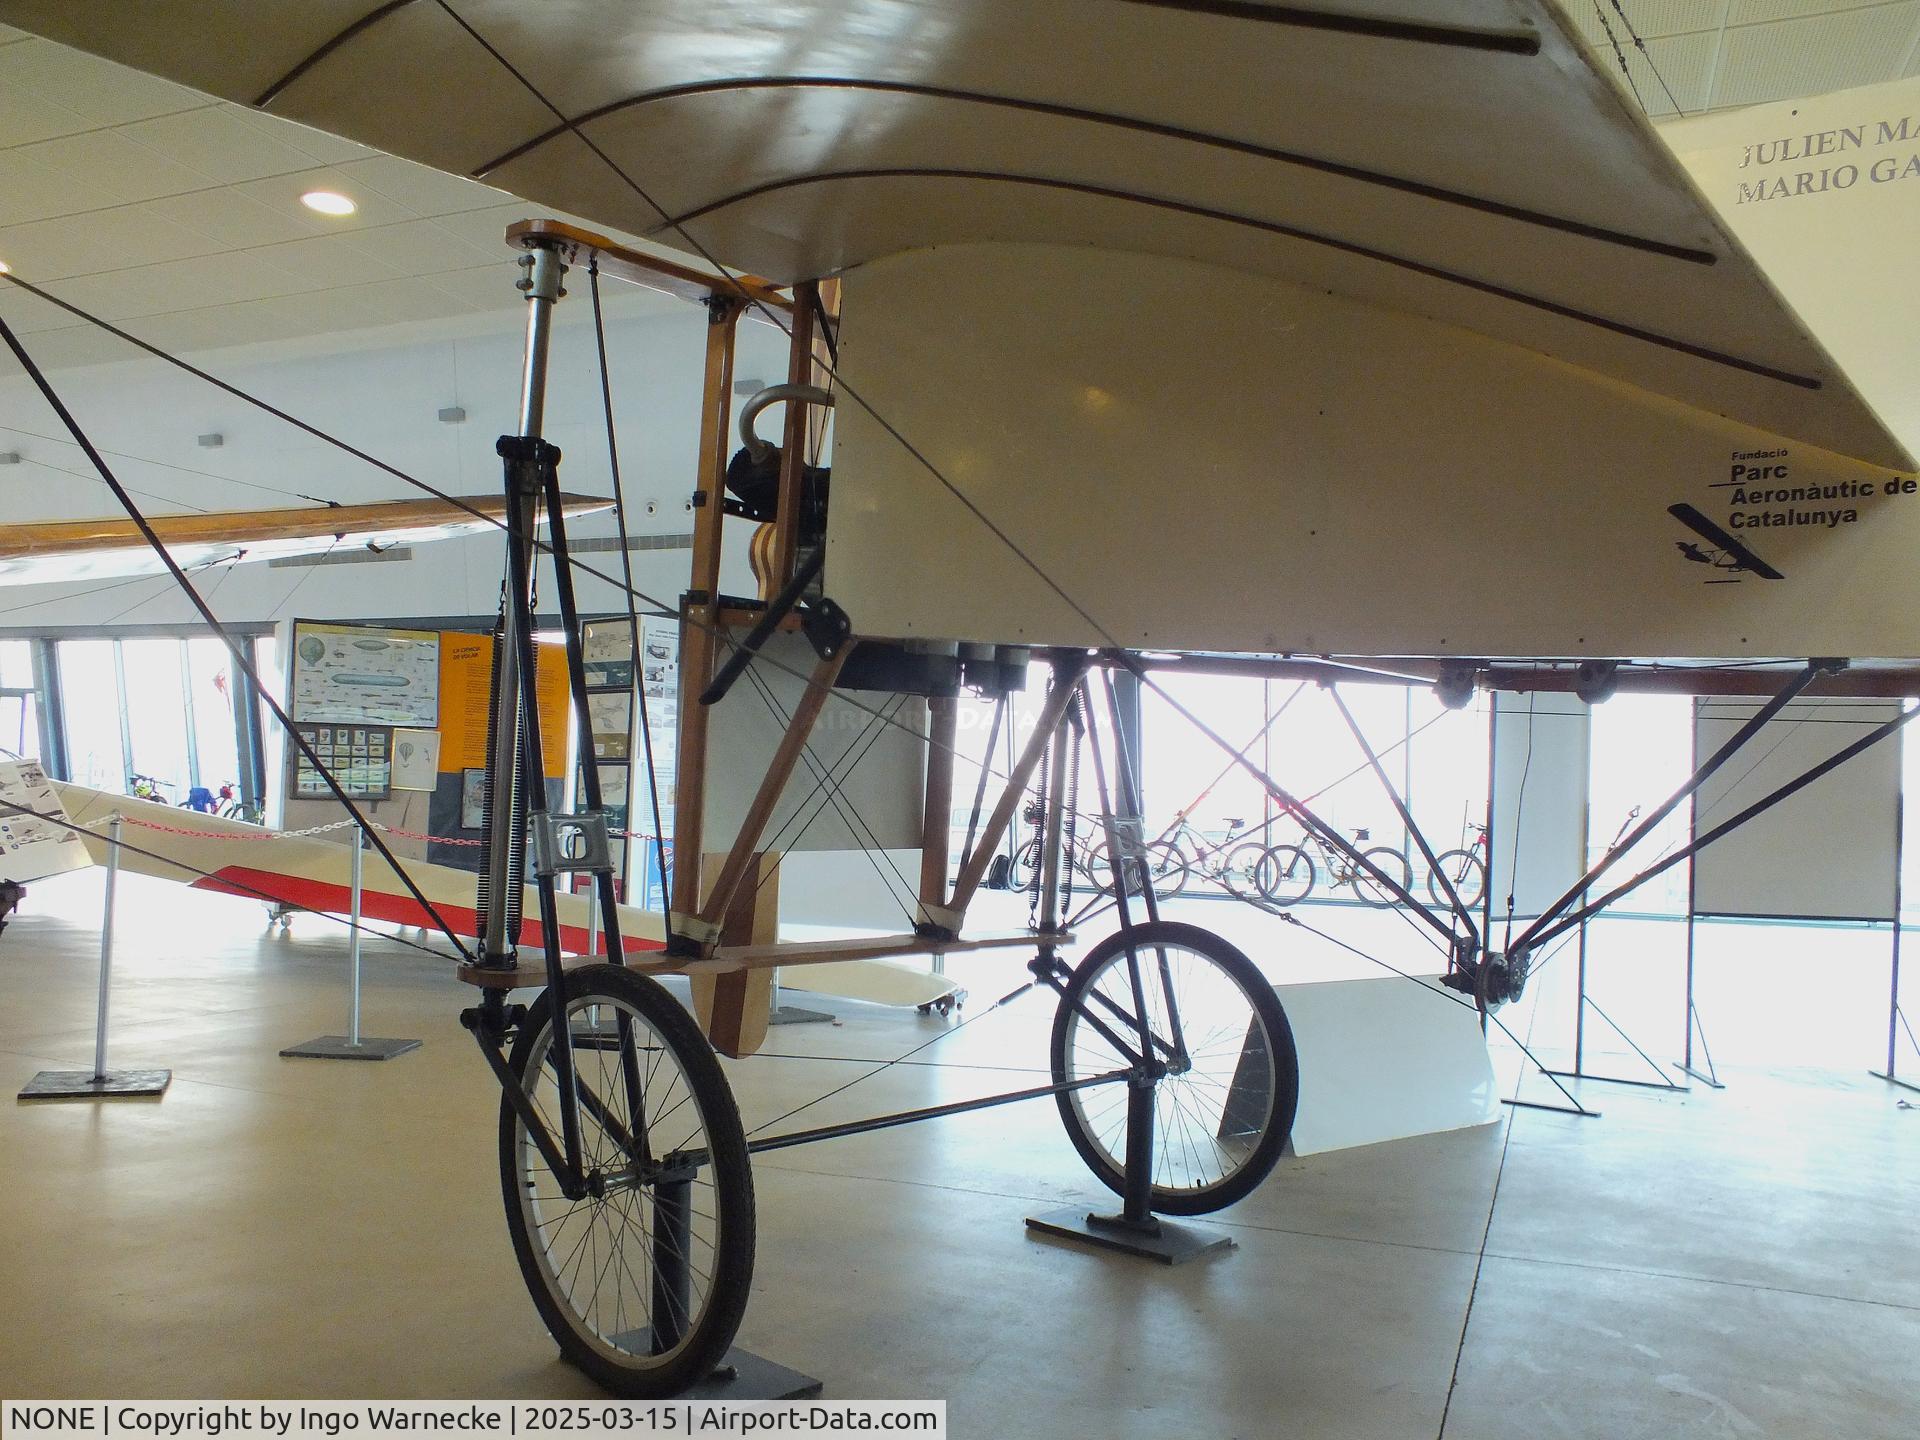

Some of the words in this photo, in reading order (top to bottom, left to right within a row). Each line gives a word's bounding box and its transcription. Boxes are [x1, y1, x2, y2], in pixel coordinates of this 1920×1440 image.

[1738, 125, 1867, 169] JULIEN
[1735, 164, 1859, 205] MARIO
[1731, 448, 1789, 461] Fundació
[1730, 464, 1789, 482] Parc
[1730, 480, 1875, 505] Aeronàutic
[1883, 477, 1918, 496] de
[1729, 508, 1858, 529] Catalunya
